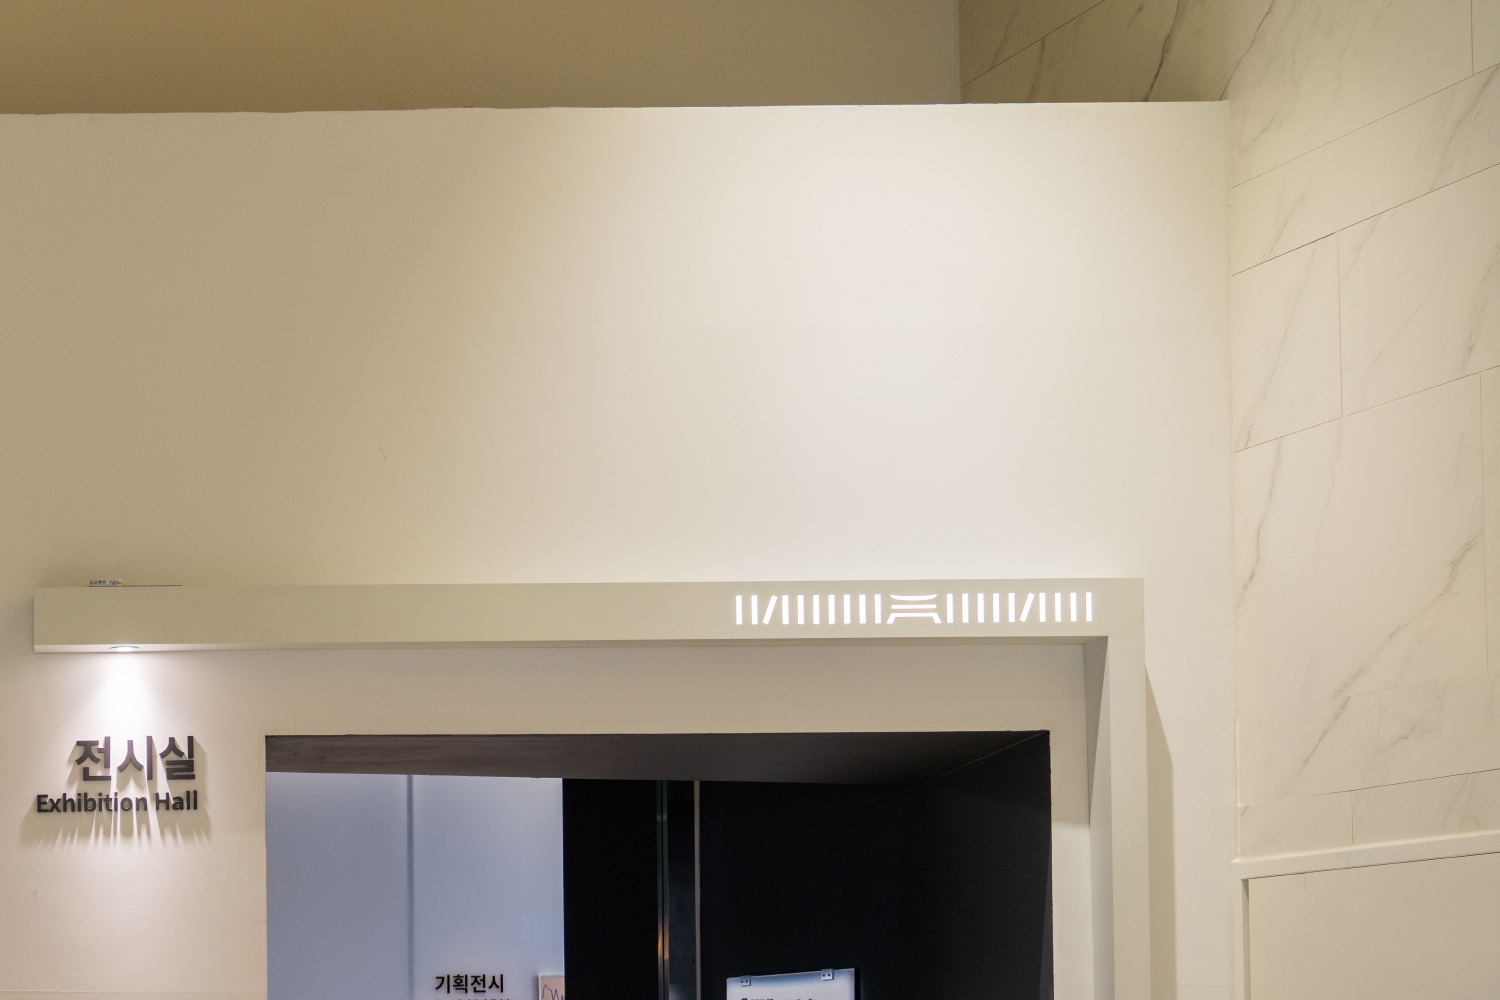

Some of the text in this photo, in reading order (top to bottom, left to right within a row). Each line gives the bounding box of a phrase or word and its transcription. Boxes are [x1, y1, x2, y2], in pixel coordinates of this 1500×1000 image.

[75, 735, 196, 781] 전시실
[36, 790, 198, 813] Exhibition Hall
[435, 974, 504, 994] 기획전시
